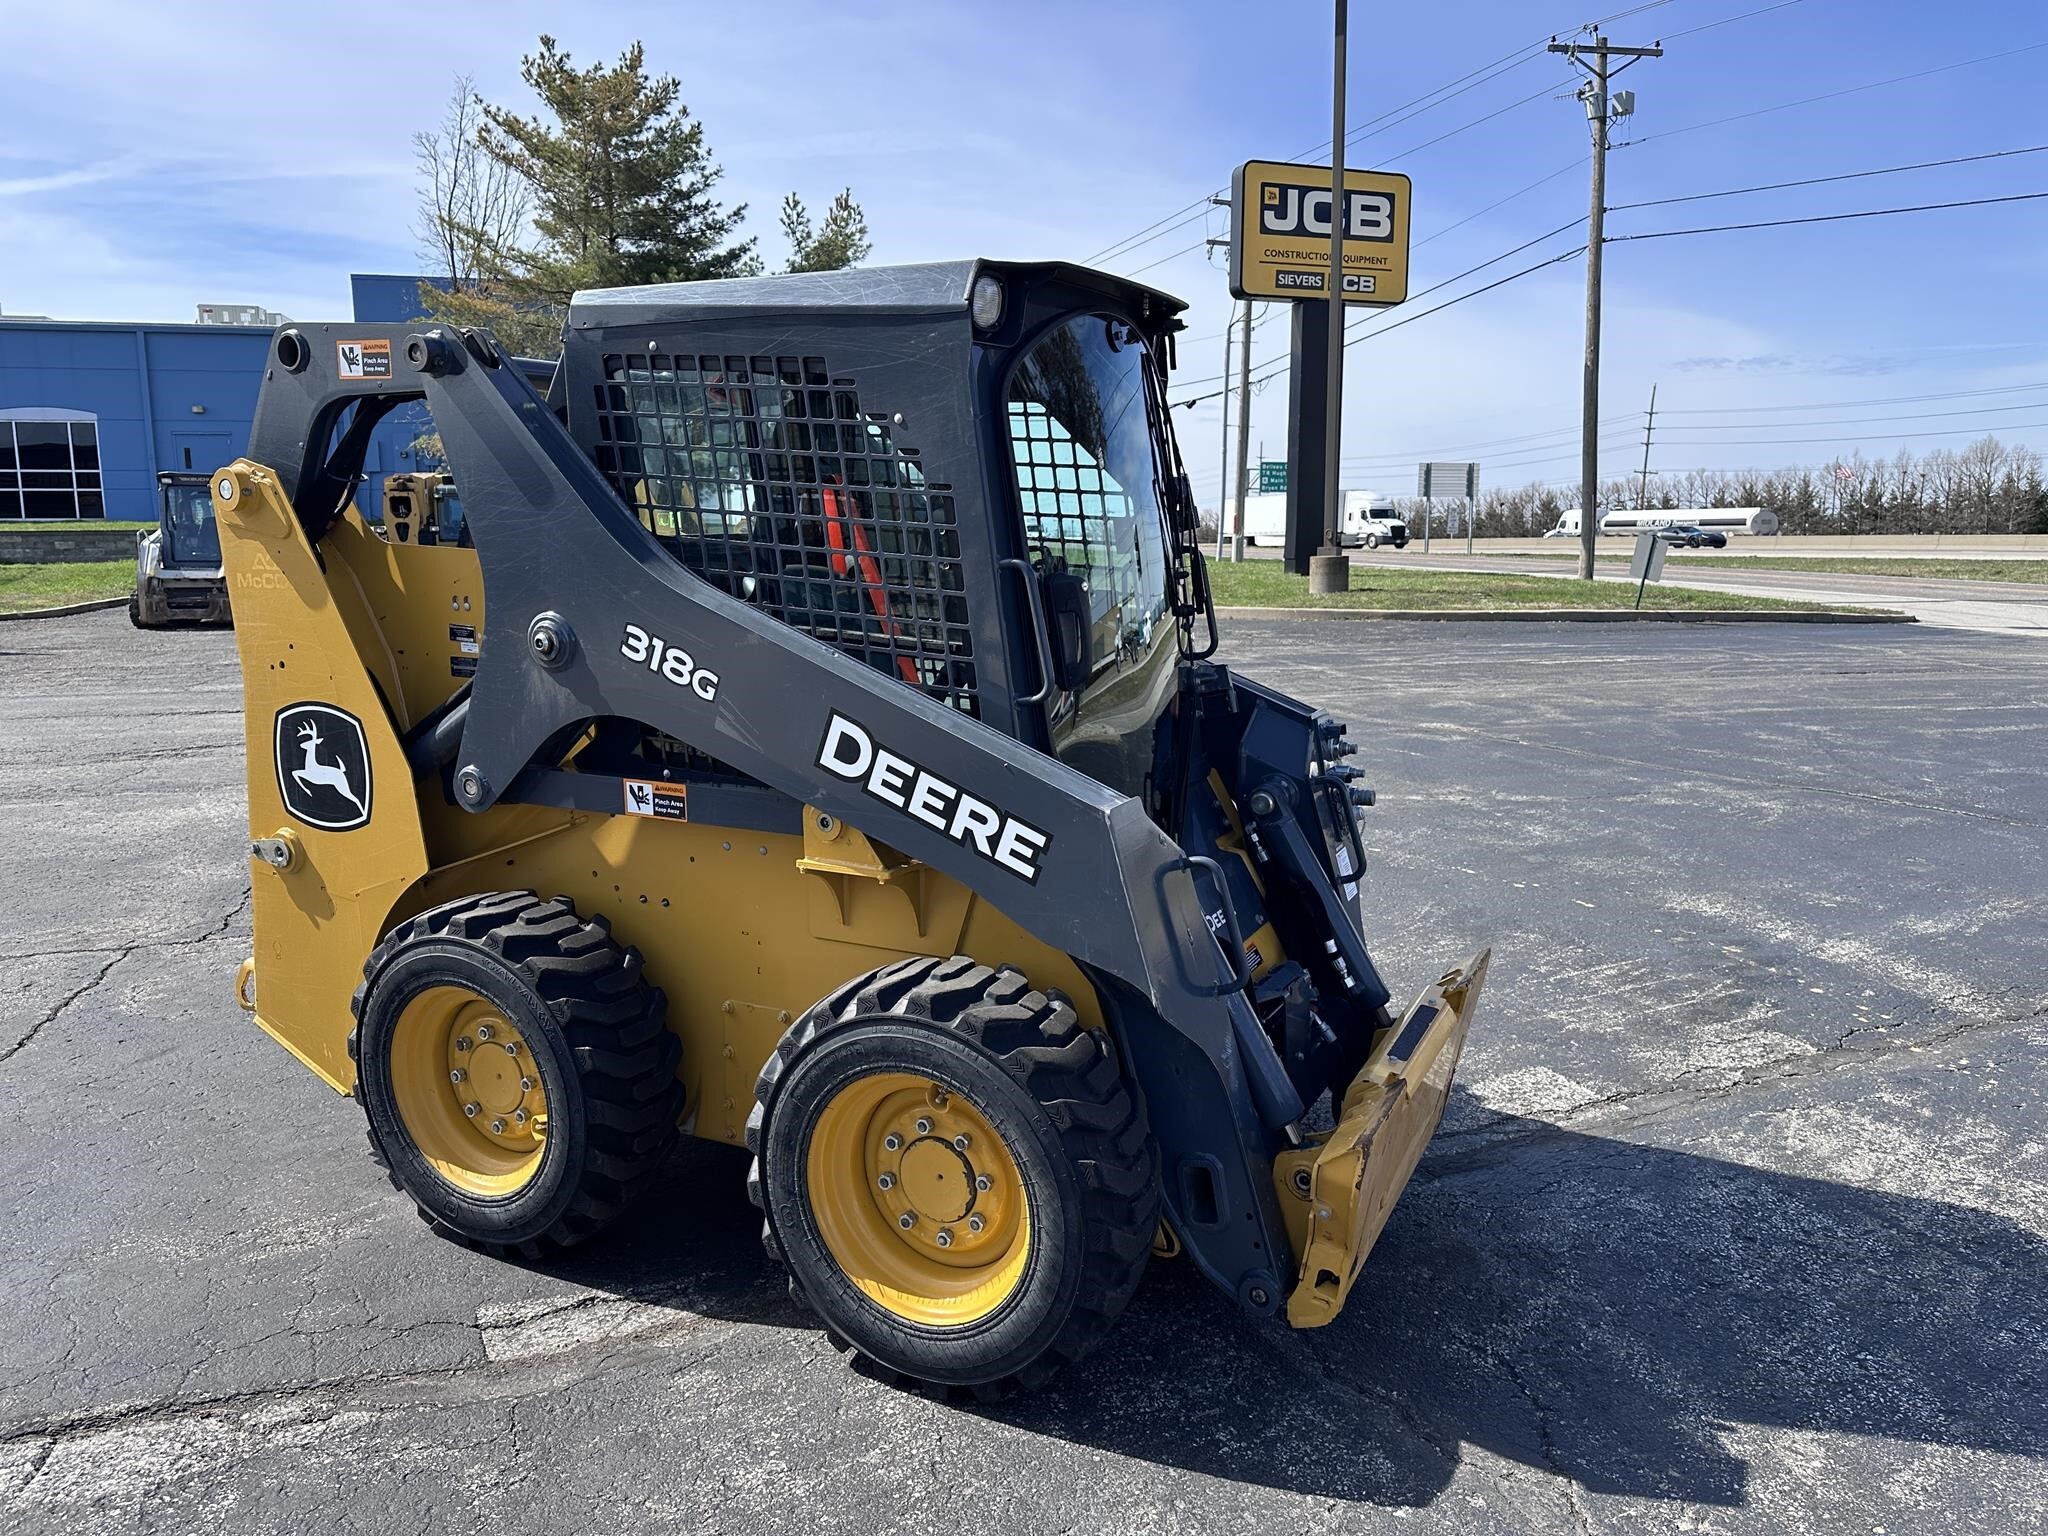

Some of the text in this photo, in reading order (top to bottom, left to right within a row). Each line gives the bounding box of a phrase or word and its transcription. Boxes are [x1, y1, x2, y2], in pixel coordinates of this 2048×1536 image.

[1263, 188, 1391, 238] JCB
[1264, 248, 1389, 266] CONSTRUCTIO QUIPMENT
[1278, 273, 1375, 292] SIEVERS CB
[621, 624, 719, 701] 318G
[819, 713, 1047, 880] DEERE
[1204, 909, 1227, 932] DEE
